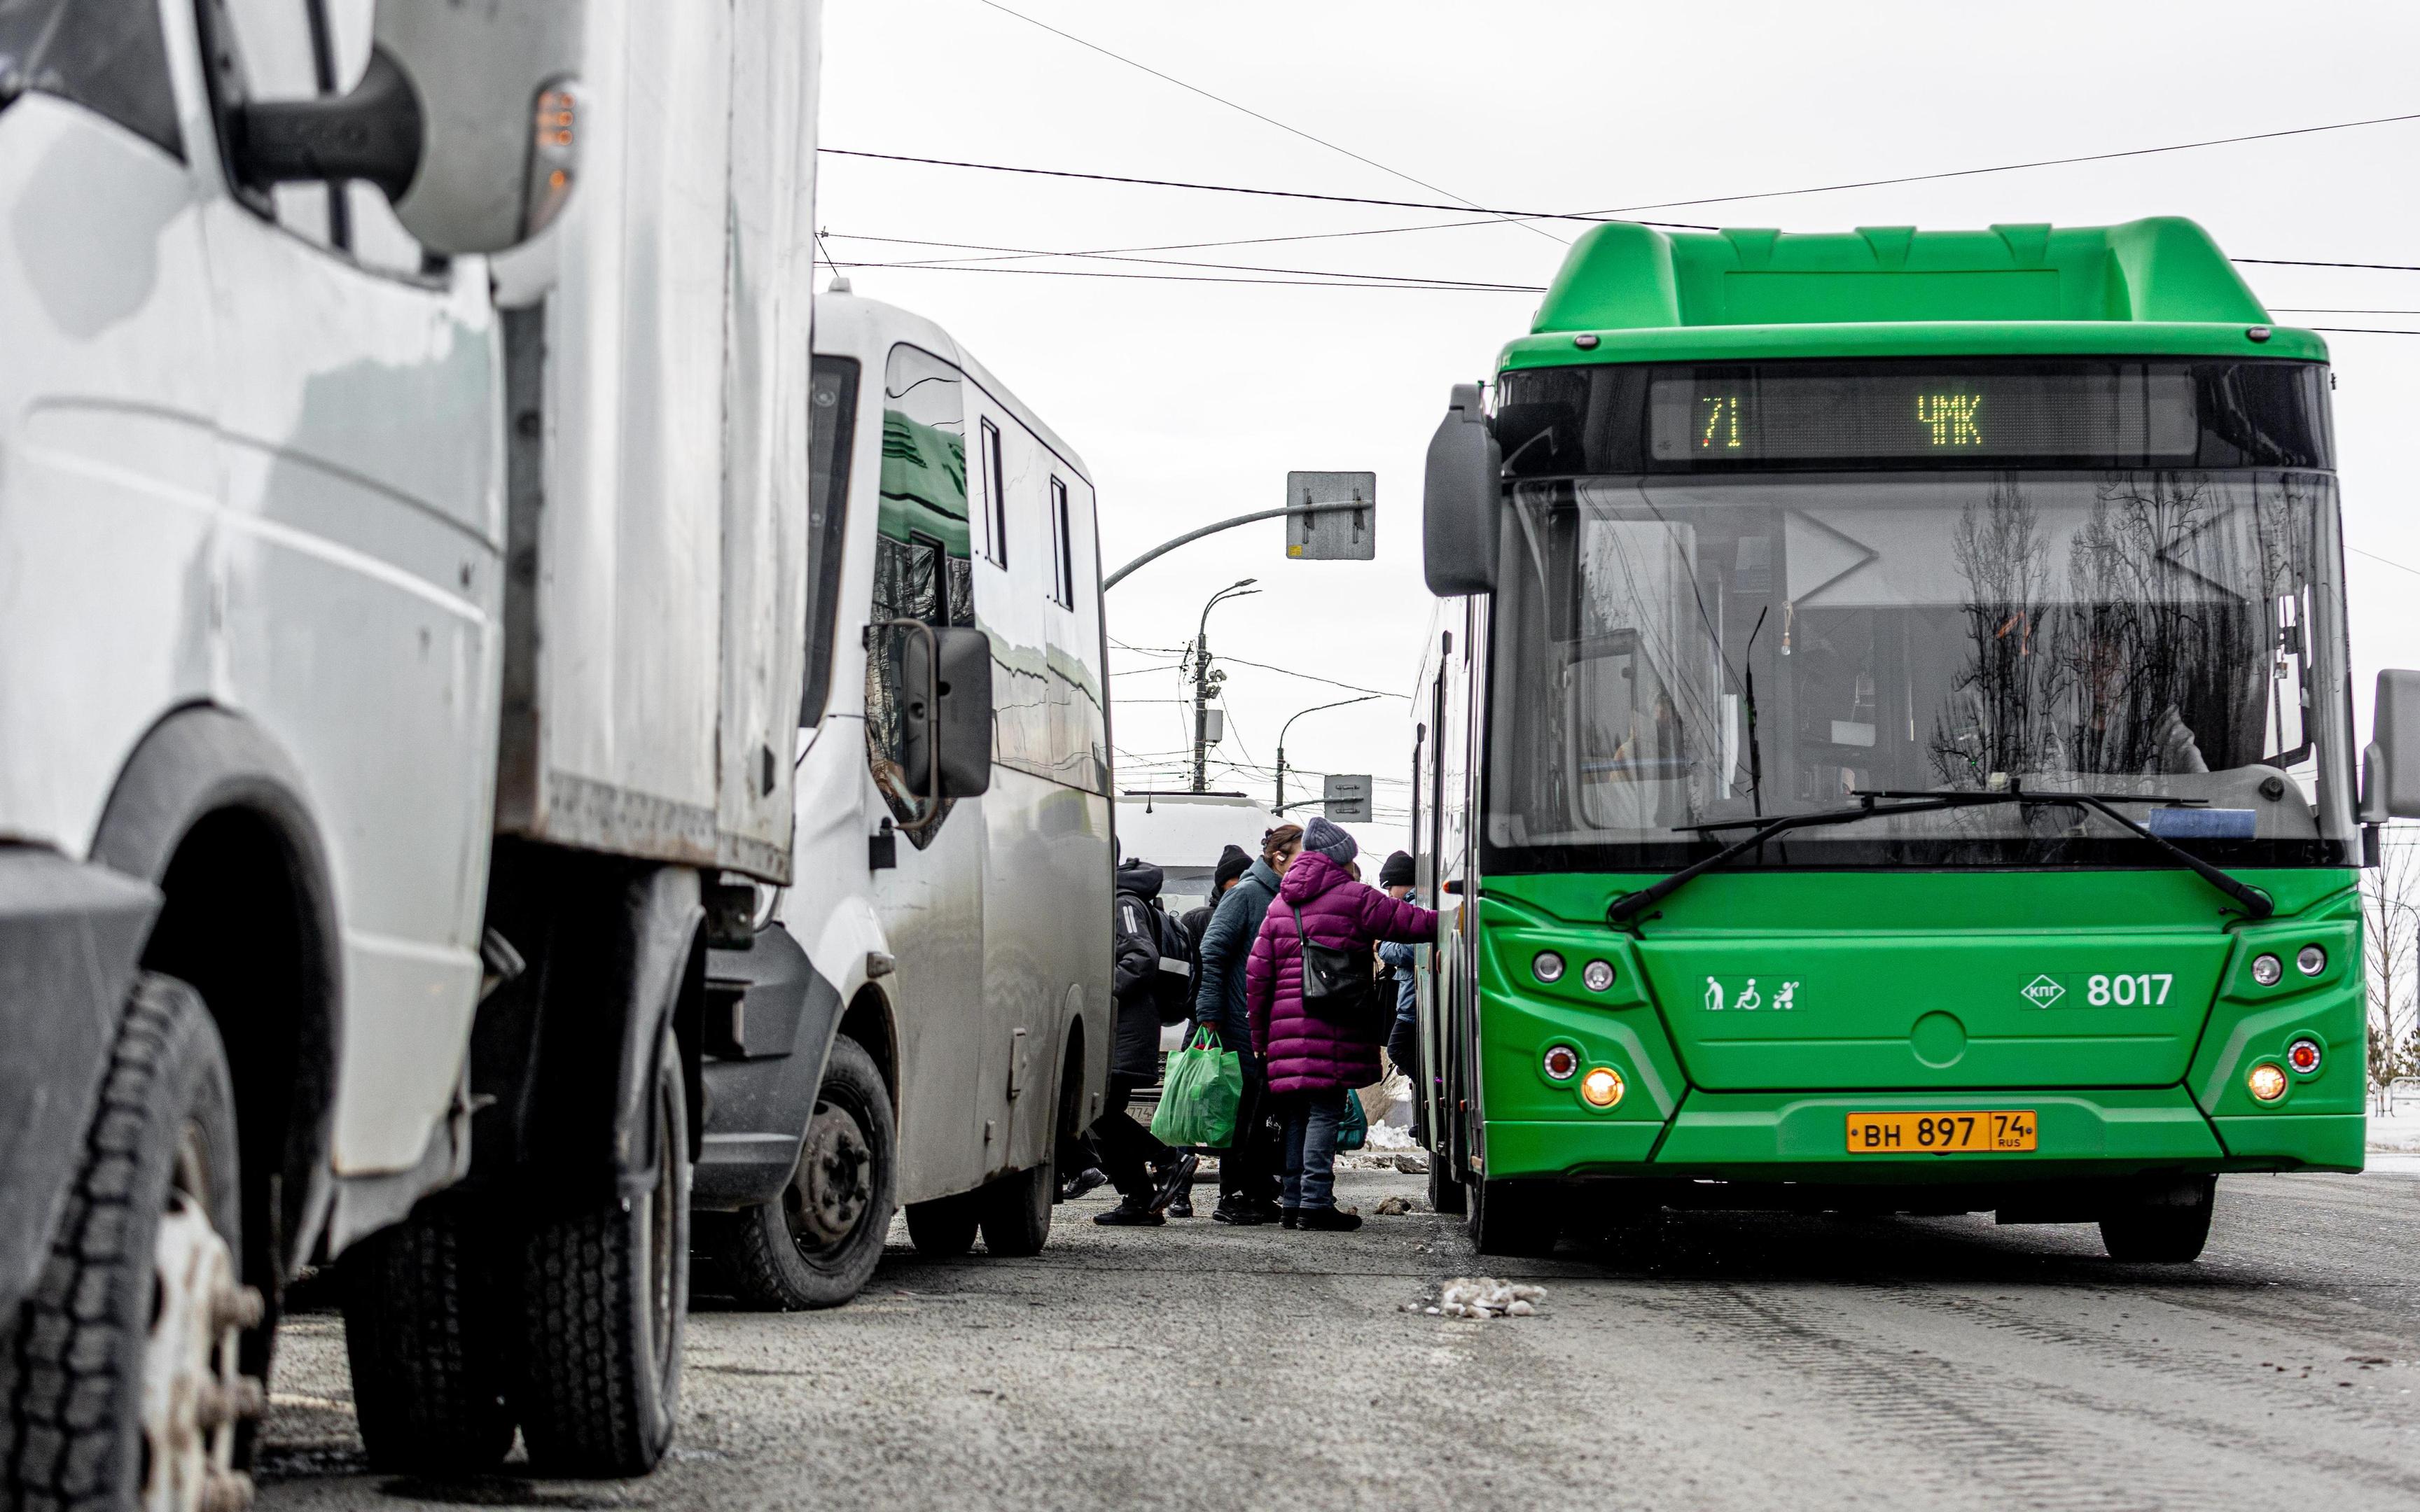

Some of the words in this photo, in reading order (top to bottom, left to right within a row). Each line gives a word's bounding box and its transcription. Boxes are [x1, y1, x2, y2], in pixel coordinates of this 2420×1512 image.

[1702, 397, 1741, 447] 71
[1919, 395, 1981, 444] ЧМК
[2029, 985, 2058, 997] КПГ
[2087, 974, 2173, 1006] 8017
[1865, 1124, 1900, 1147] ВН
[1917, 1117, 1975, 1147] 897
[1994, 1115, 2024, 1138] 74
[1998, 1138, 2021, 1147] RUS
